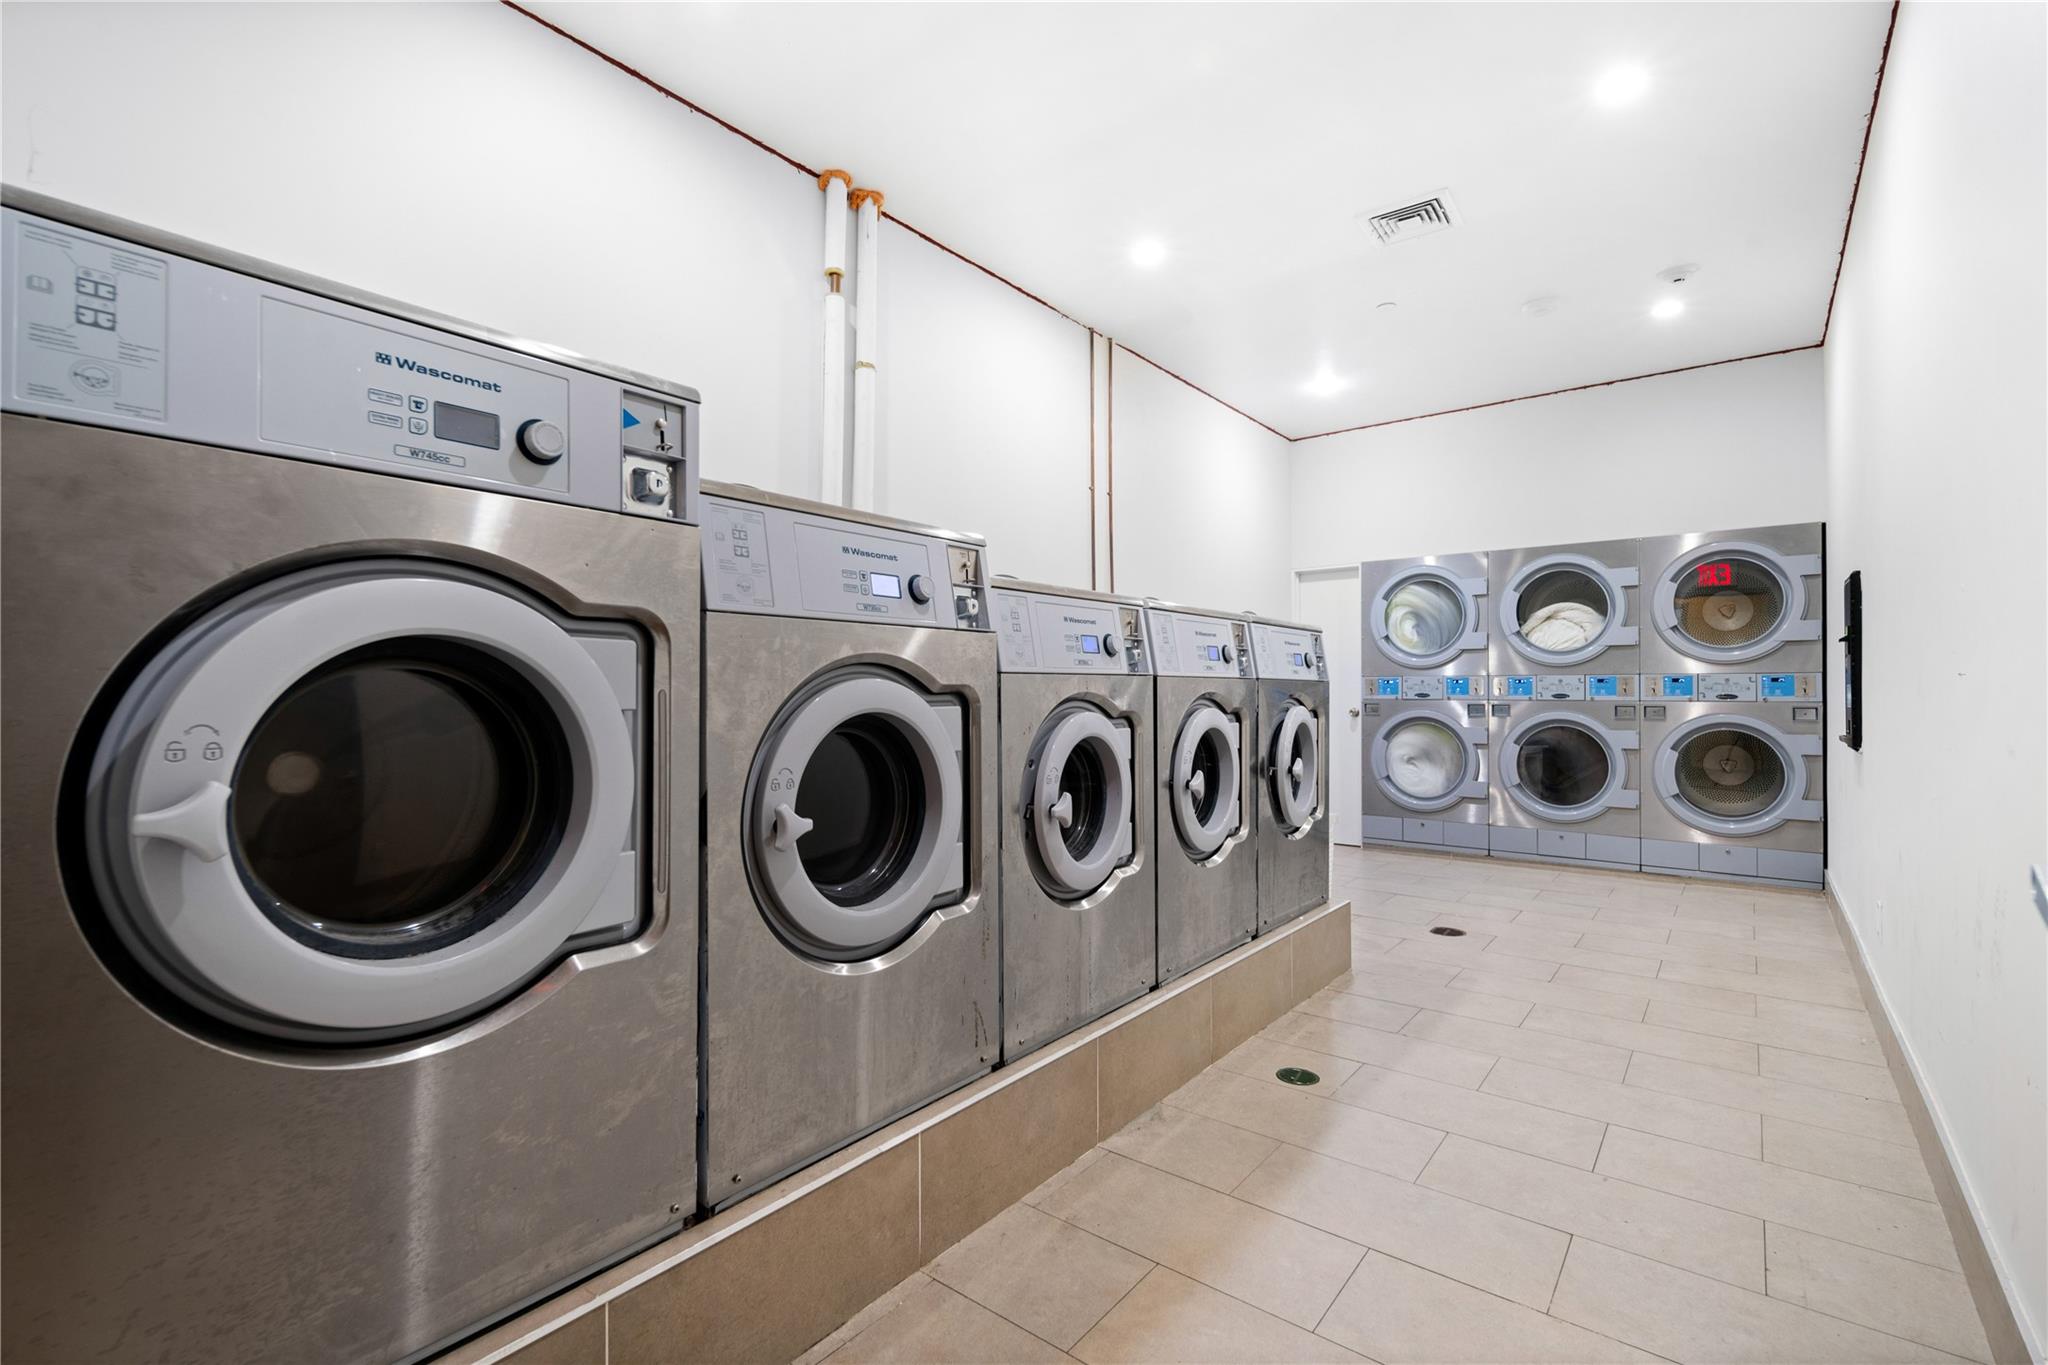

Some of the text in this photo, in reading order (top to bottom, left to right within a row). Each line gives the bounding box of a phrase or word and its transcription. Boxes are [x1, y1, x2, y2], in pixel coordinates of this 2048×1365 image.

[395, 356, 502, 393] Wascomat
[409, 448, 451, 464] W745cc
[851, 547, 898, 561] Wascomat
